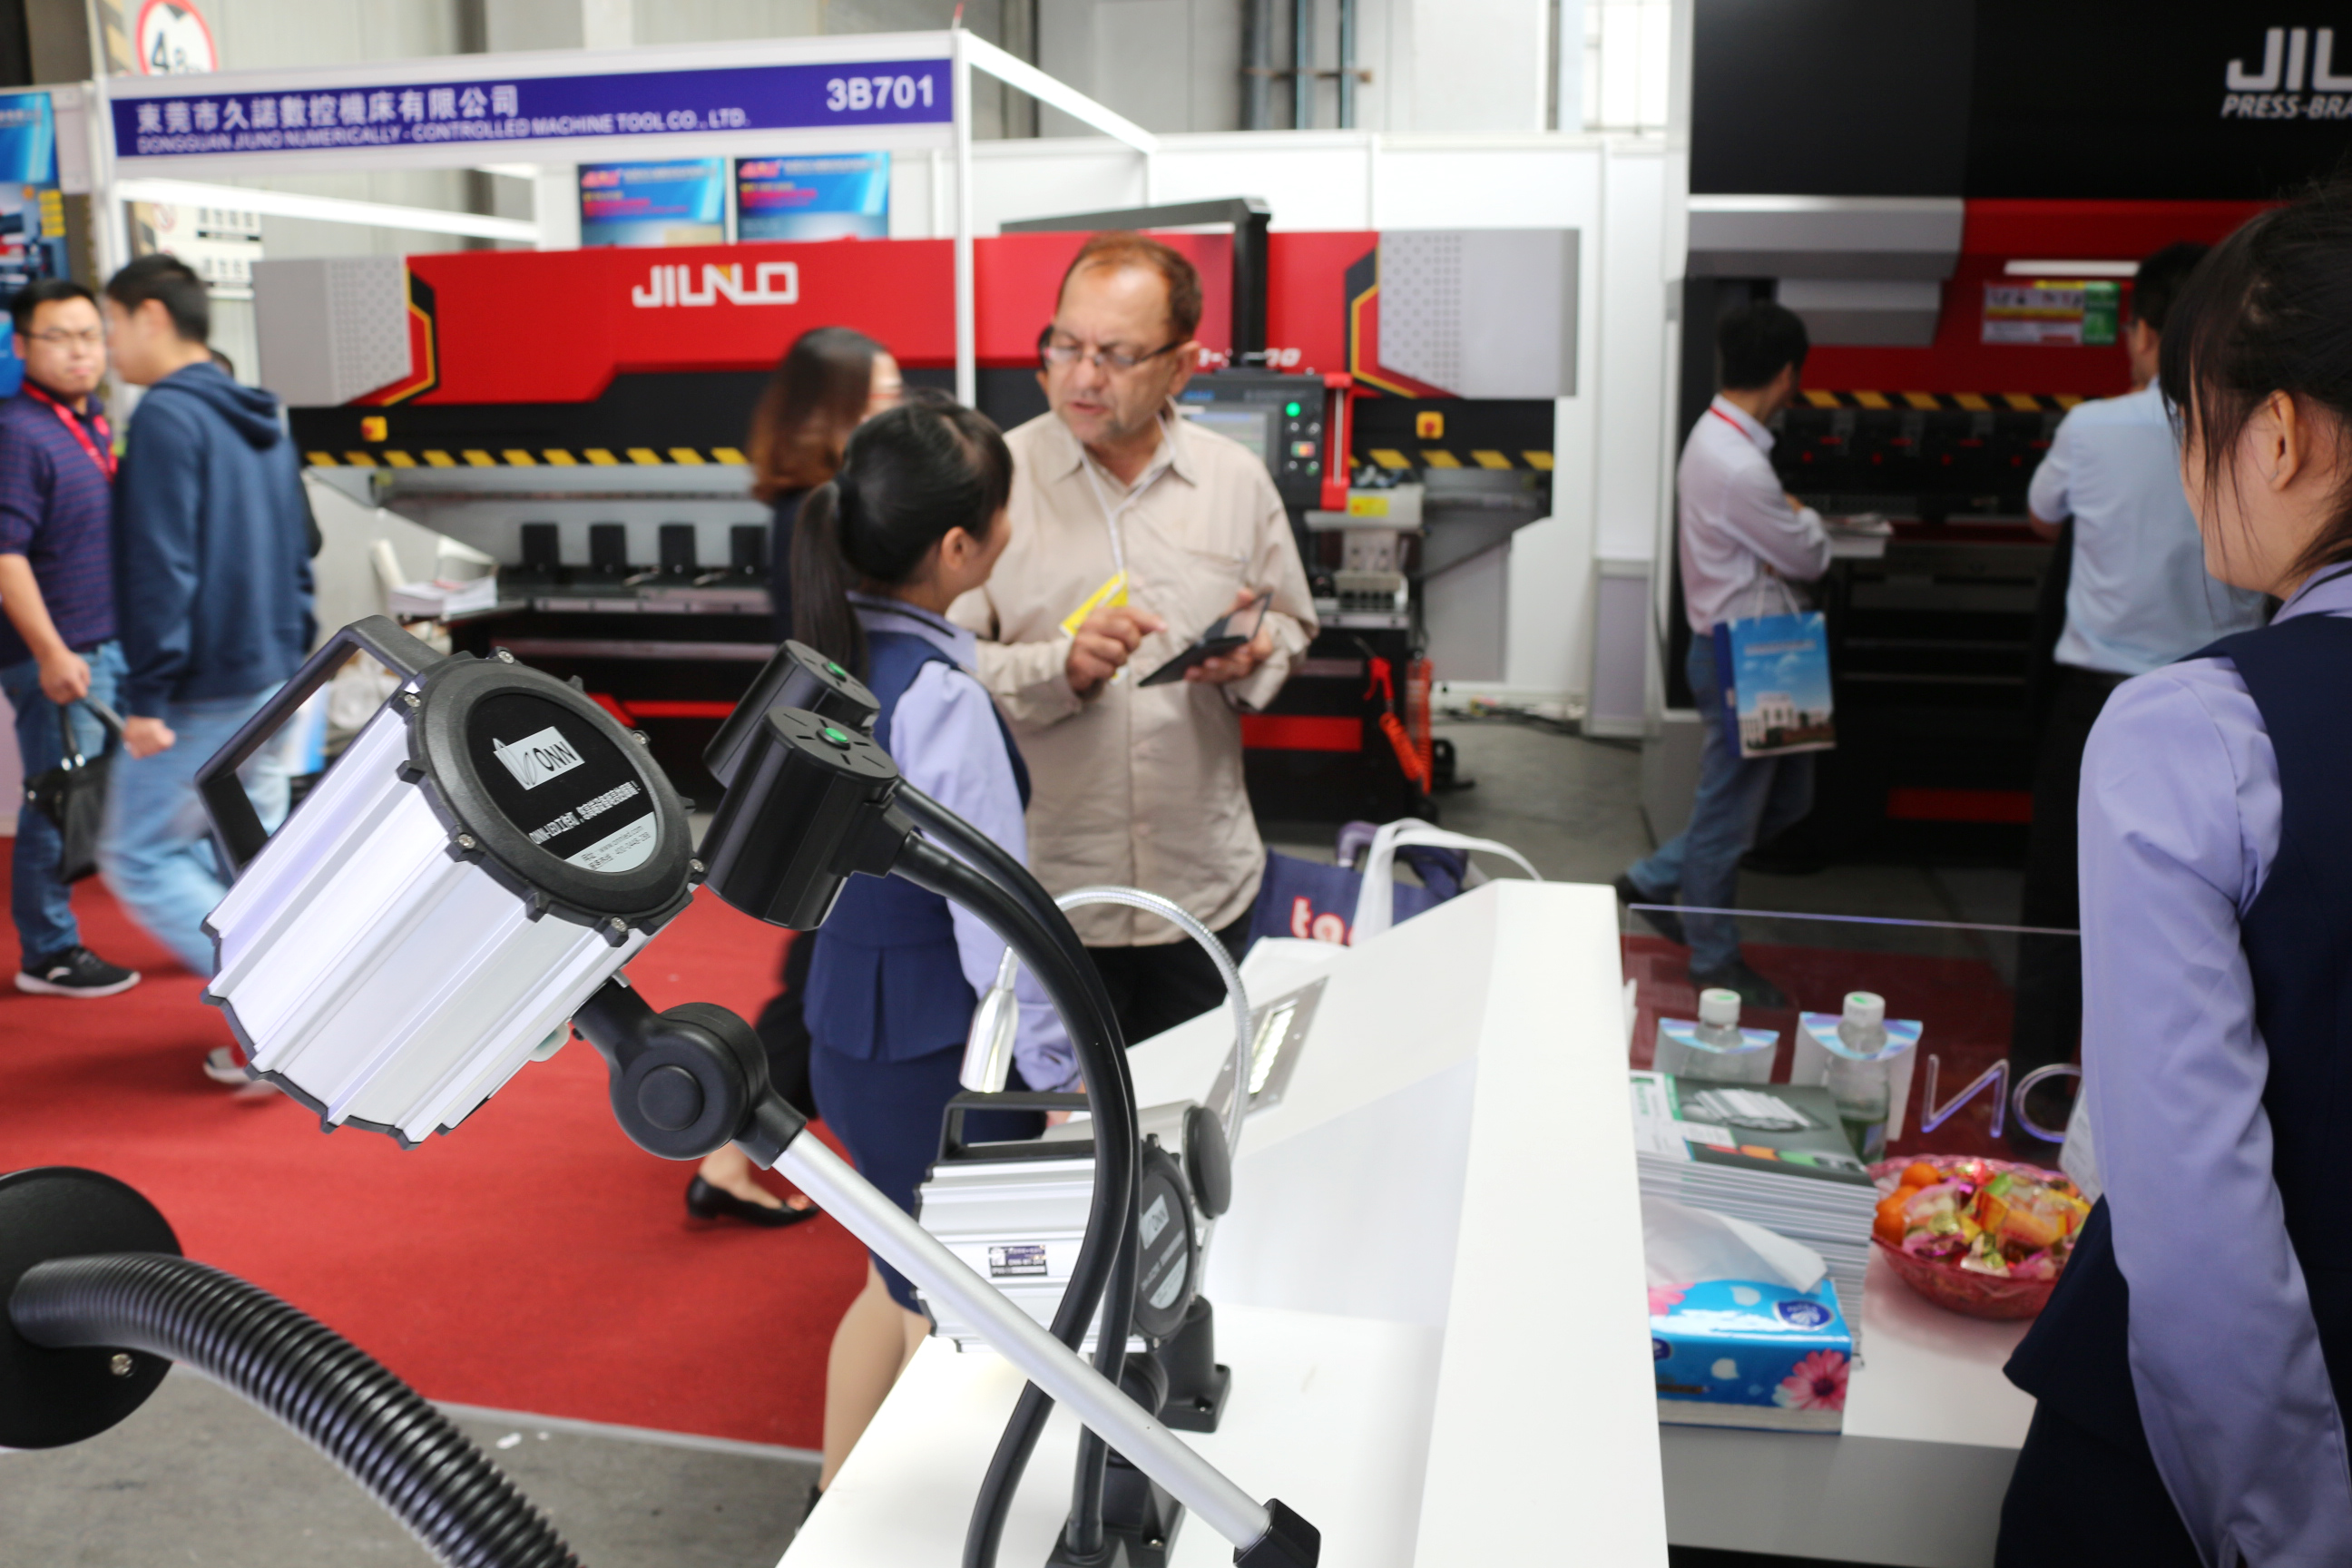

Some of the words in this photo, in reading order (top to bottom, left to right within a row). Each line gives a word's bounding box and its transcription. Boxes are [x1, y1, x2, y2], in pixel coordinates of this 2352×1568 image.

[826, 74, 925, 112] 3B701
[137, 133, 232, 155] DONGGUAN
[285, 123, 402, 149] NUMERICALLY
[411, 117, 531, 143] CONTROLLED
[531, 113, 615, 136] MACHINE
[615, 111, 667, 133] TOOL
[532, 740, 578, 772] ONN
